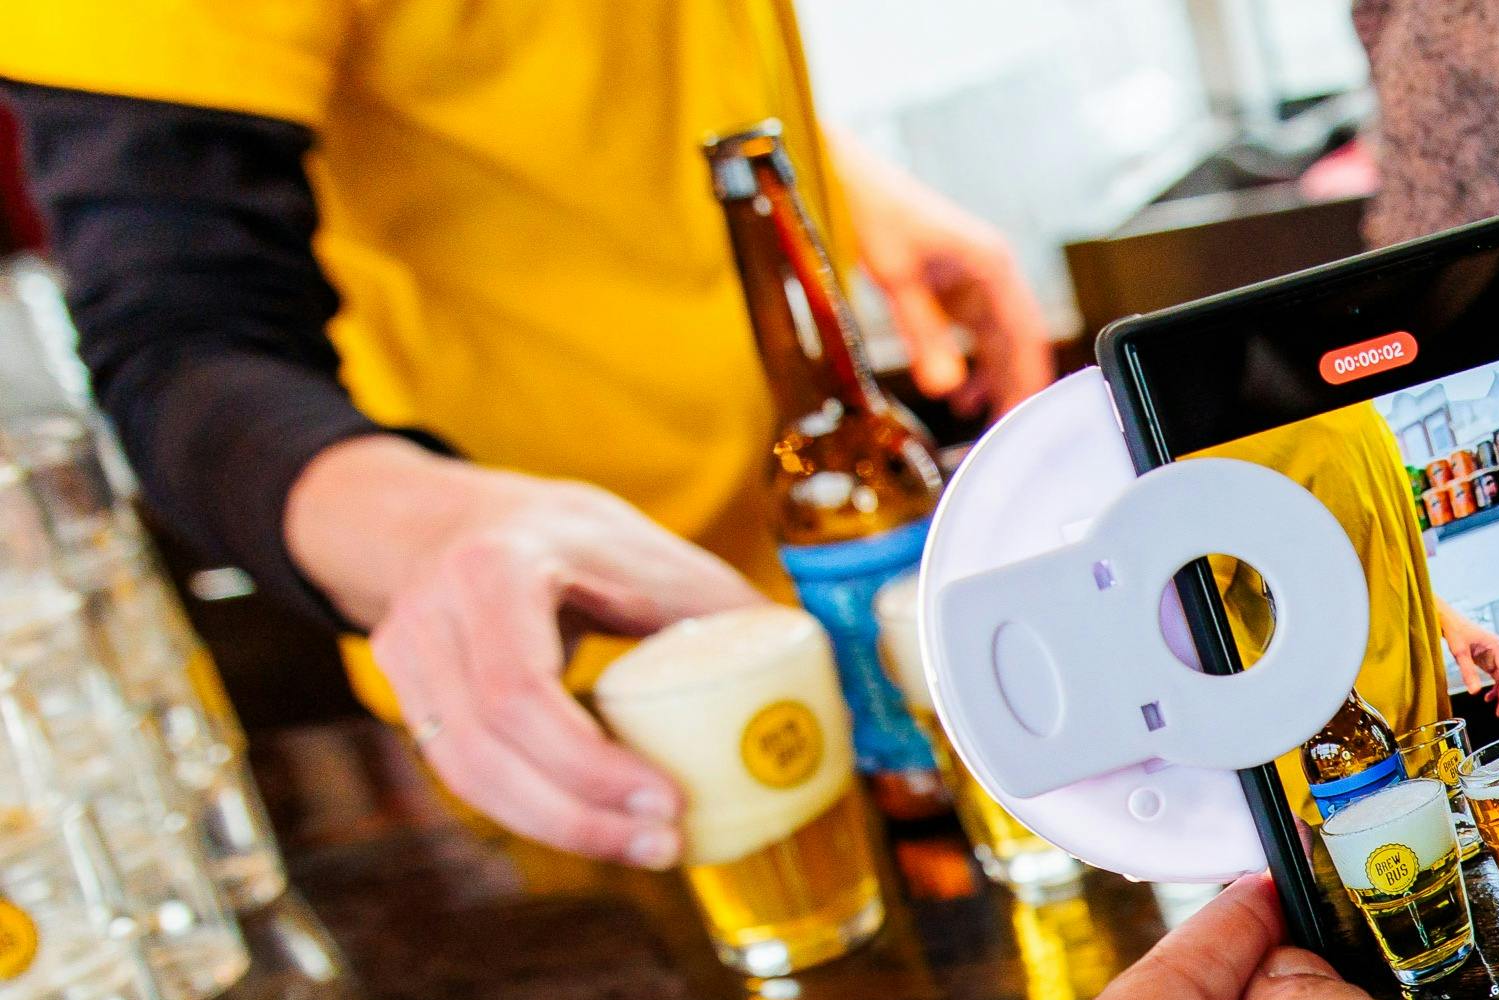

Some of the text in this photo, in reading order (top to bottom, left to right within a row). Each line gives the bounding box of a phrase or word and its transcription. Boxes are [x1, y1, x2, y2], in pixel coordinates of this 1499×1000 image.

[1333, 341, 1405, 375] 00:00:02
[1374, 851, 1402, 877] BREW
[1385, 863, 1409, 886] BUS
